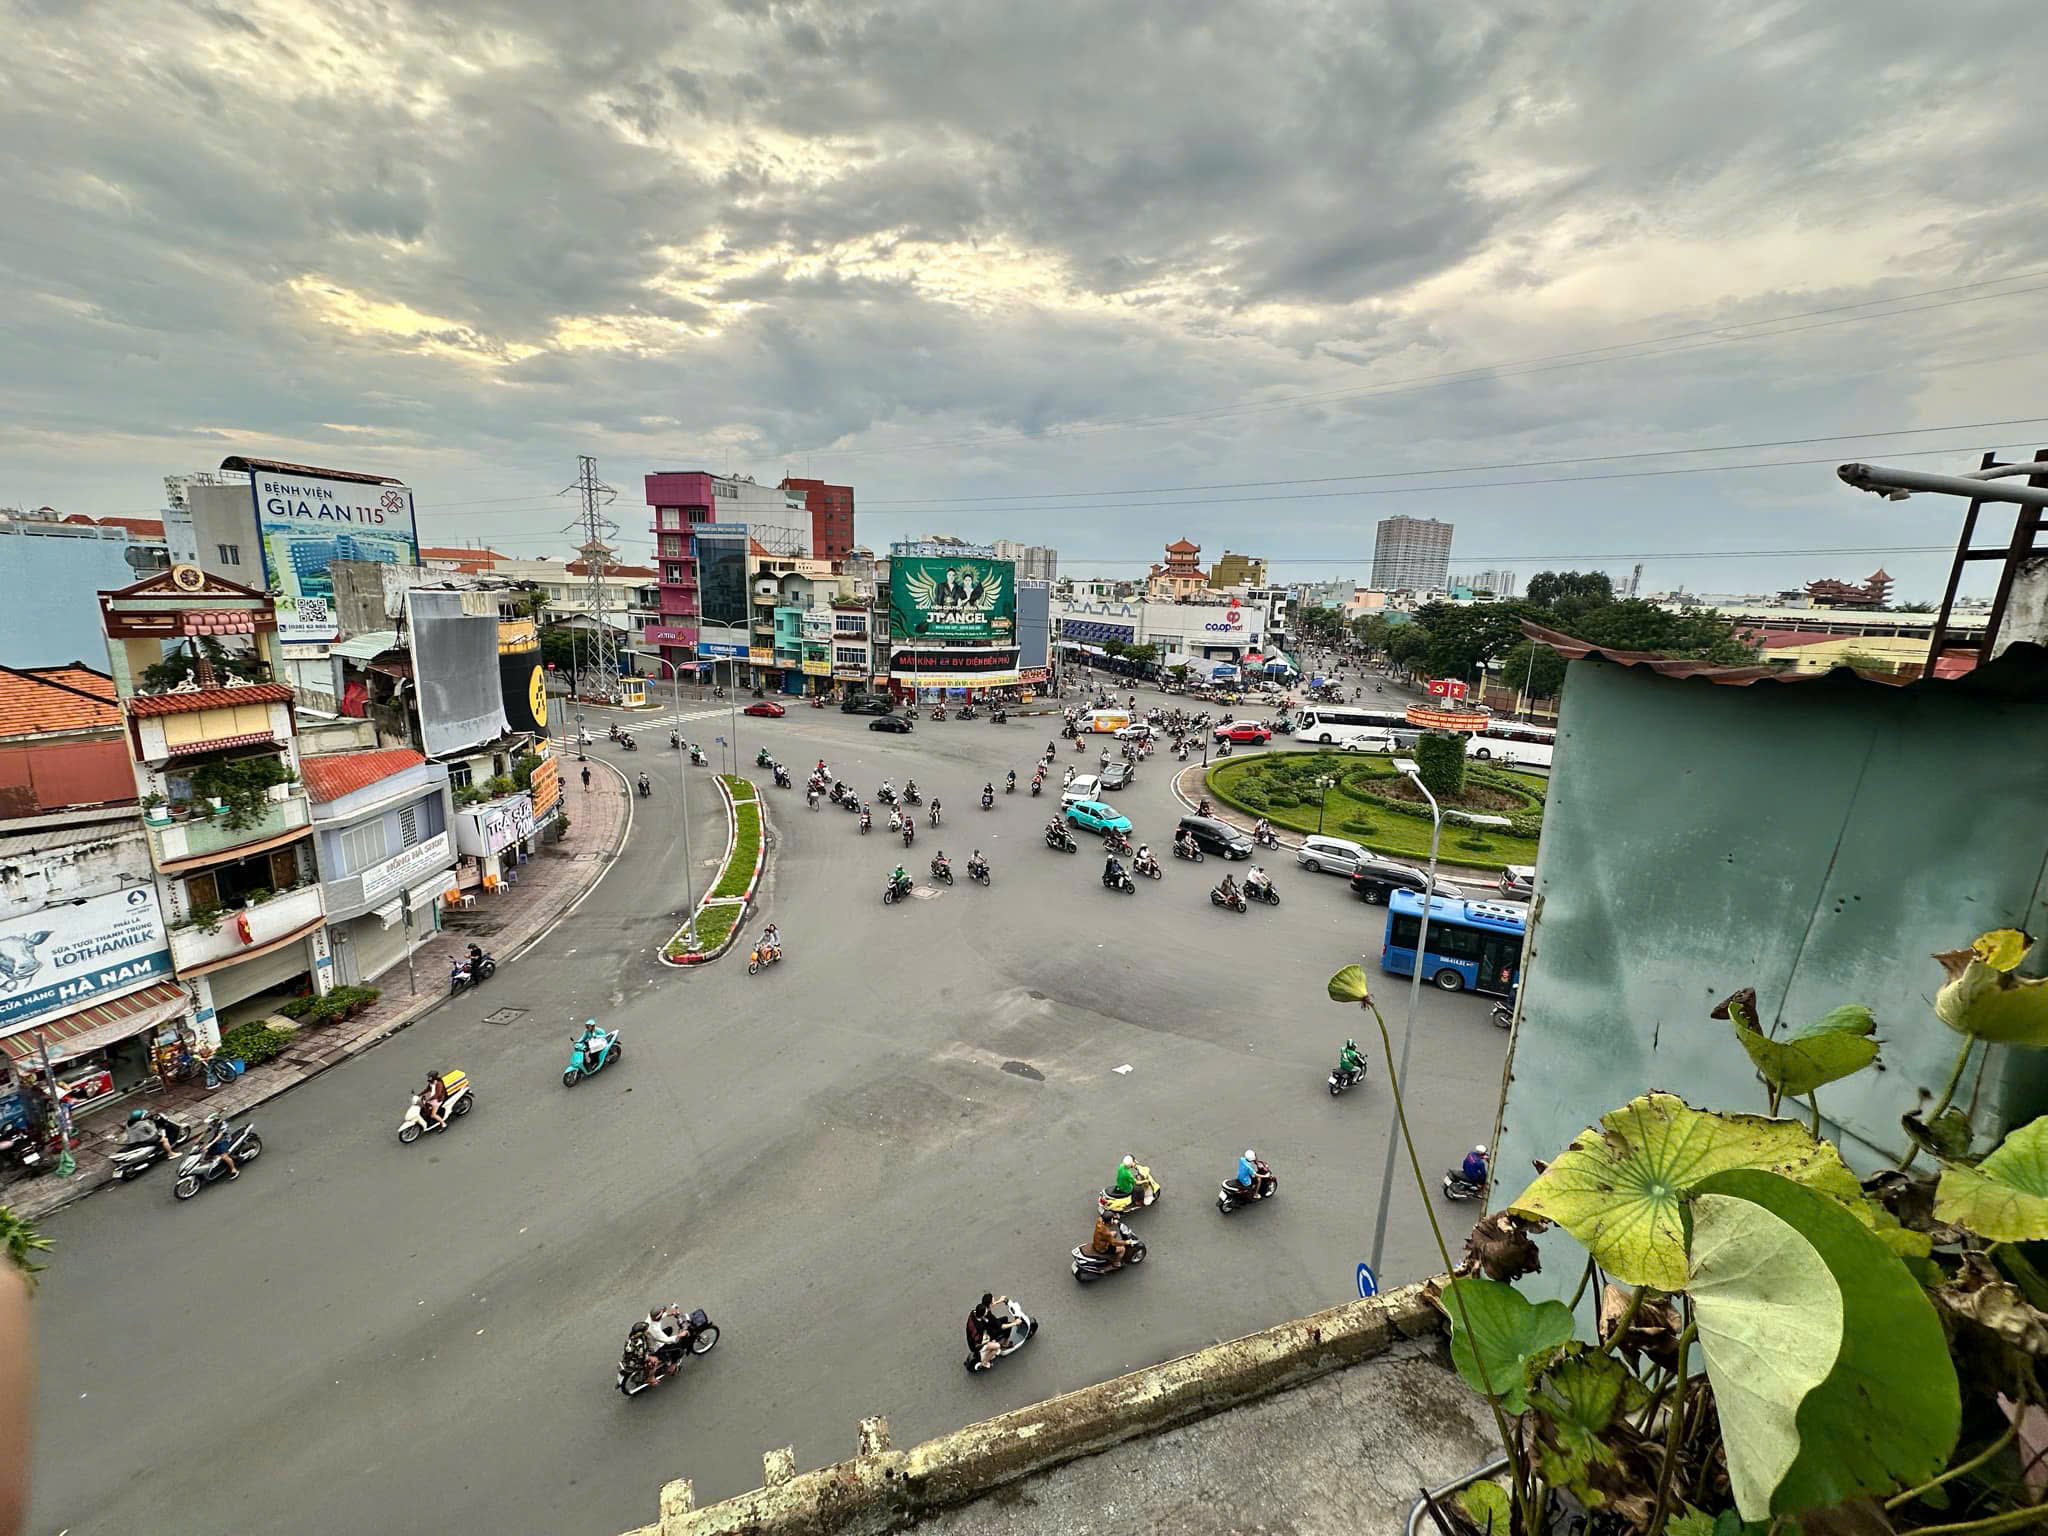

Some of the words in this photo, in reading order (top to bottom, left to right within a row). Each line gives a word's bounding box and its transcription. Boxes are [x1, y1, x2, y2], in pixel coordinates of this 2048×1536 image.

[264, 482, 300, 496] BỆNH
[303, 486, 333, 500] VIỆN
[267, 498, 313, 519] GIA
[318, 503, 352, 522] AN
[356, 506, 385, 524] 115
[53, 929, 156, 968] LOTHAMILK
[24, 989, 56, 1005] HÀNG
[58, 976, 96, 1000] HÀ
[100, 960, 152, 986] NAM
